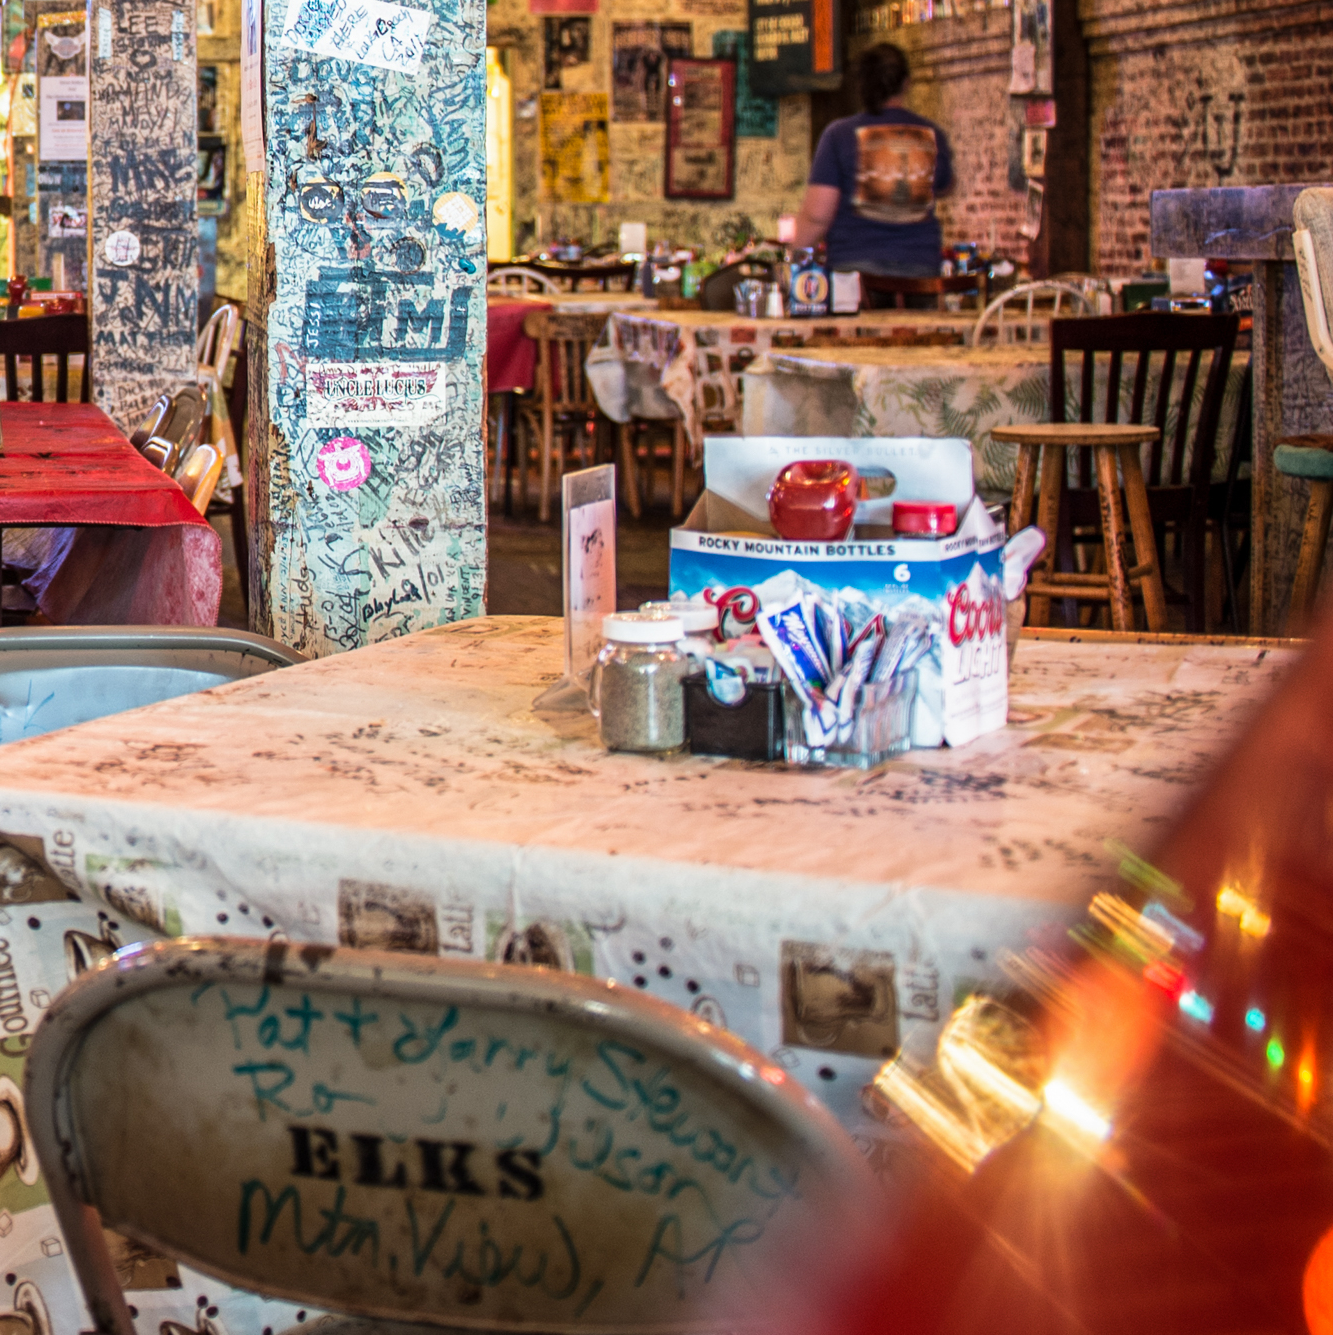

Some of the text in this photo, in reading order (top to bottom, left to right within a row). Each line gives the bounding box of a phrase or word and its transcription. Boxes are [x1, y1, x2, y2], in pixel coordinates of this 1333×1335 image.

[324, 375, 428, 399] UNCLE LUCIUS
[815, 445, 859, 456] SILVER
[698, 536, 897, 557] ROCKY MOUNTAIN BOTTLES
[892, 562, 912, 583] 6
[947, 581, 1004, 647] Coors
[952, 642, 1005, 687] LIGHT
[286, 1122, 546, 1202] ELKS
